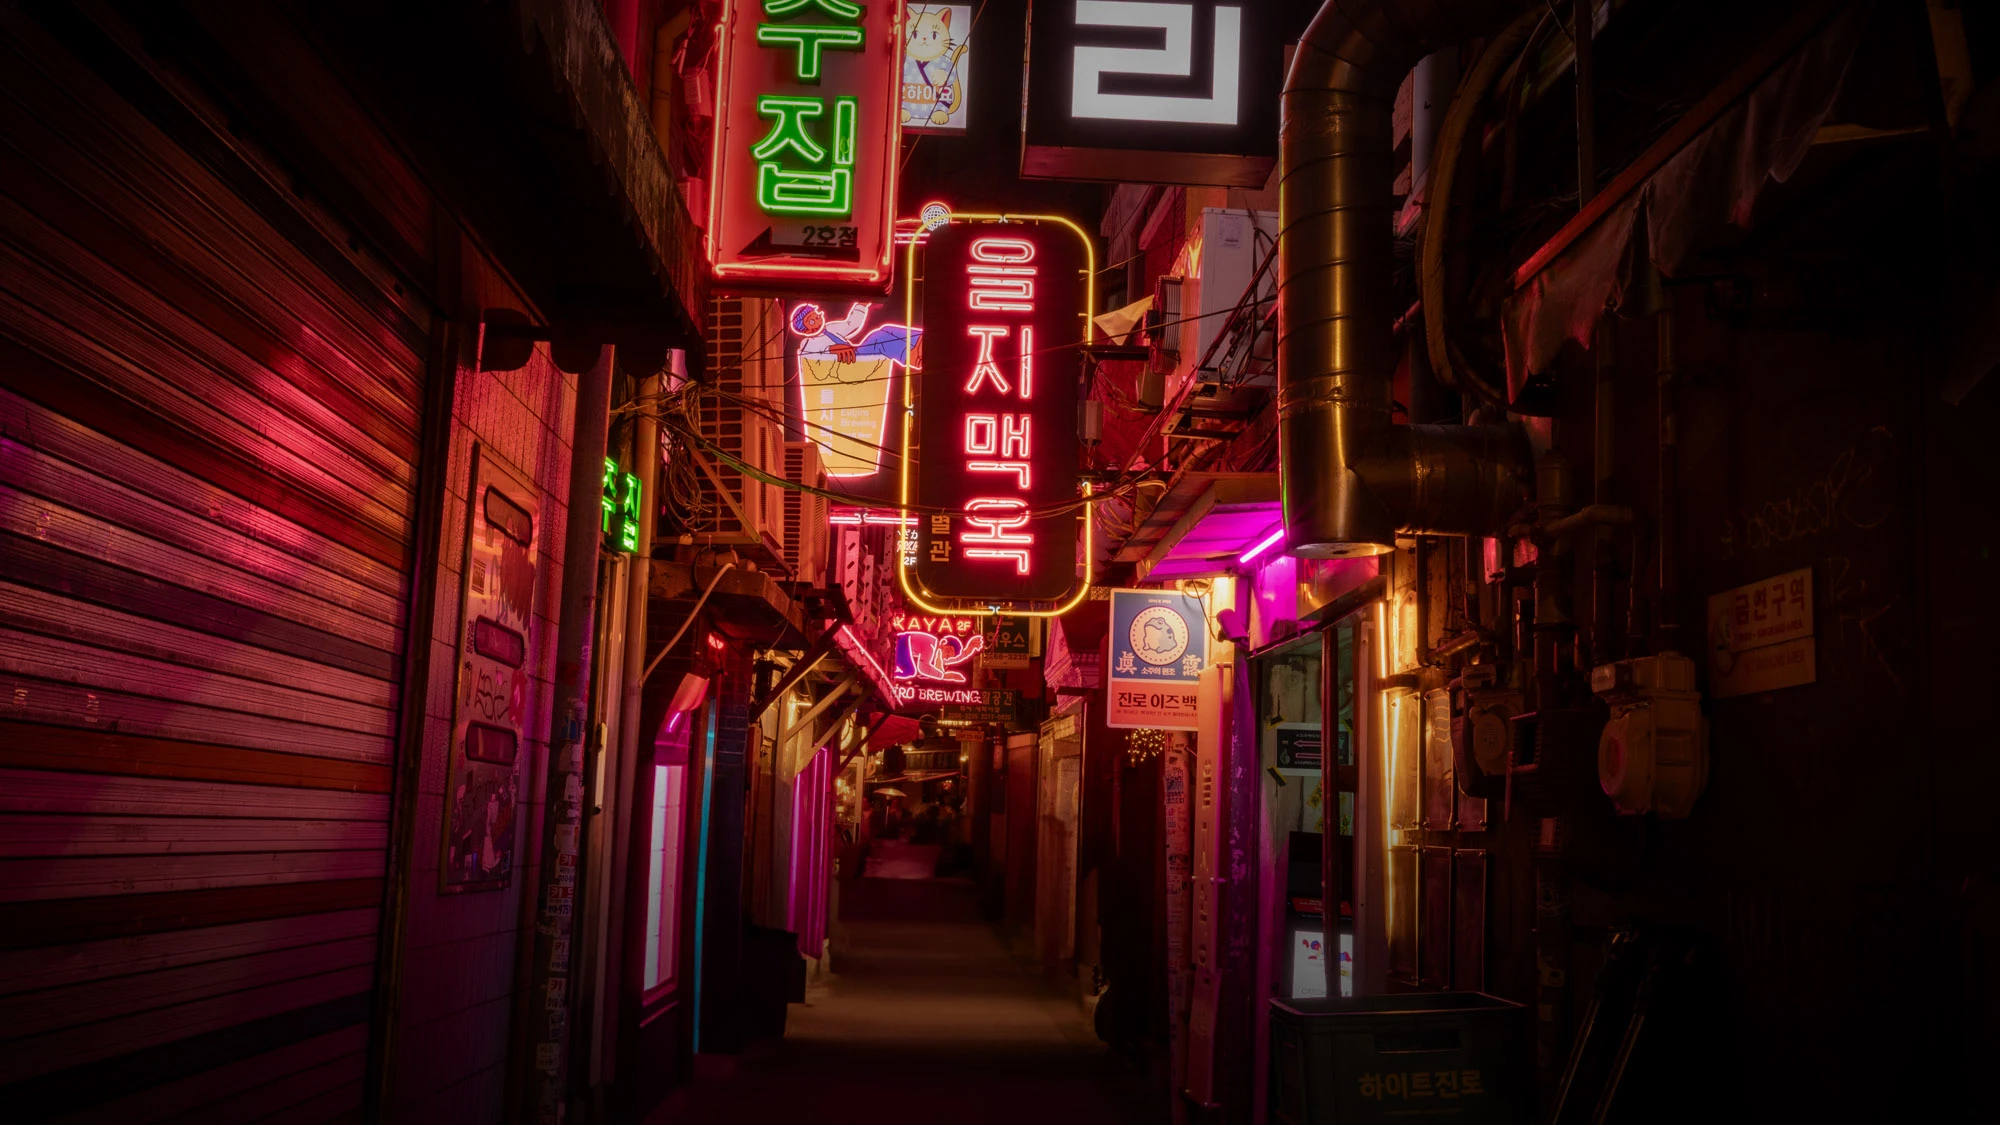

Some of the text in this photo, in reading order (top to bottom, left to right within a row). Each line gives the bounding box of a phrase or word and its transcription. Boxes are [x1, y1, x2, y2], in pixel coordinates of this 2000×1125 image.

[803, 225, 858, 247] 2호점
[960, 237, 1038, 577] 을지맥옥
[930, 515, 952, 562] 별관
[903, 556, 917, 566] 2F
[1736, 576, 1804, 626] 금연구역
[957, 620, 971, 631] 2F
[917, 688, 983, 704] BREWING
[1118, 692, 1197, 711] 진로 이즈 백
[1358, 1069, 1485, 1101] 하이트진로
